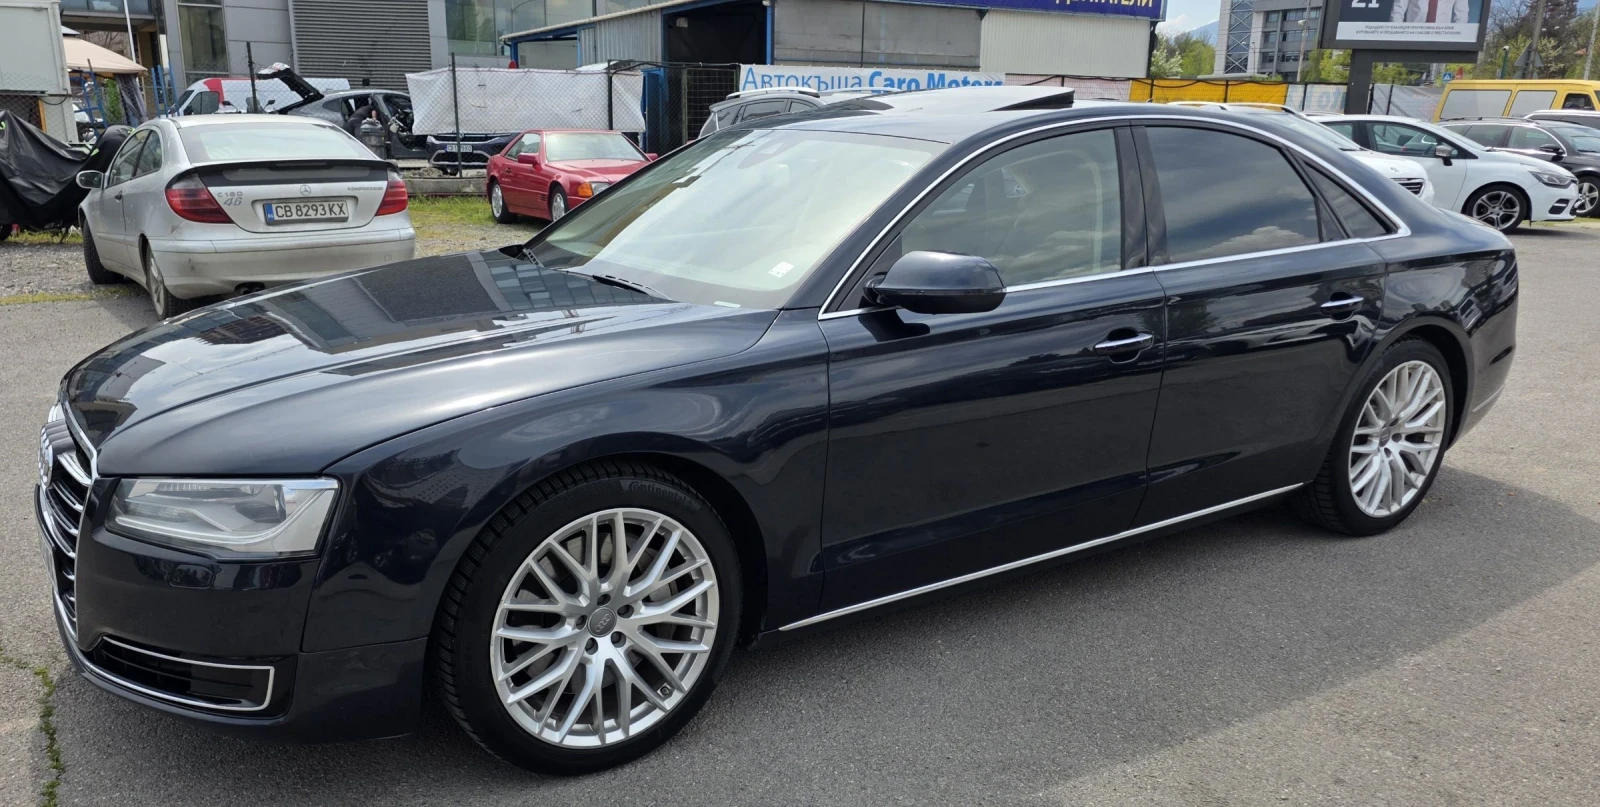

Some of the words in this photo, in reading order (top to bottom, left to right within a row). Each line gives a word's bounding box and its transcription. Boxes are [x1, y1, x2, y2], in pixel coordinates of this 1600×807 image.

[869, 71, 920, 94] Caro
[275, 205, 293, 218] CB
[295, 203, 327, 217] 8293
[328, 202, 346, 216] KX
[628, 480, 688, 502] Continental
